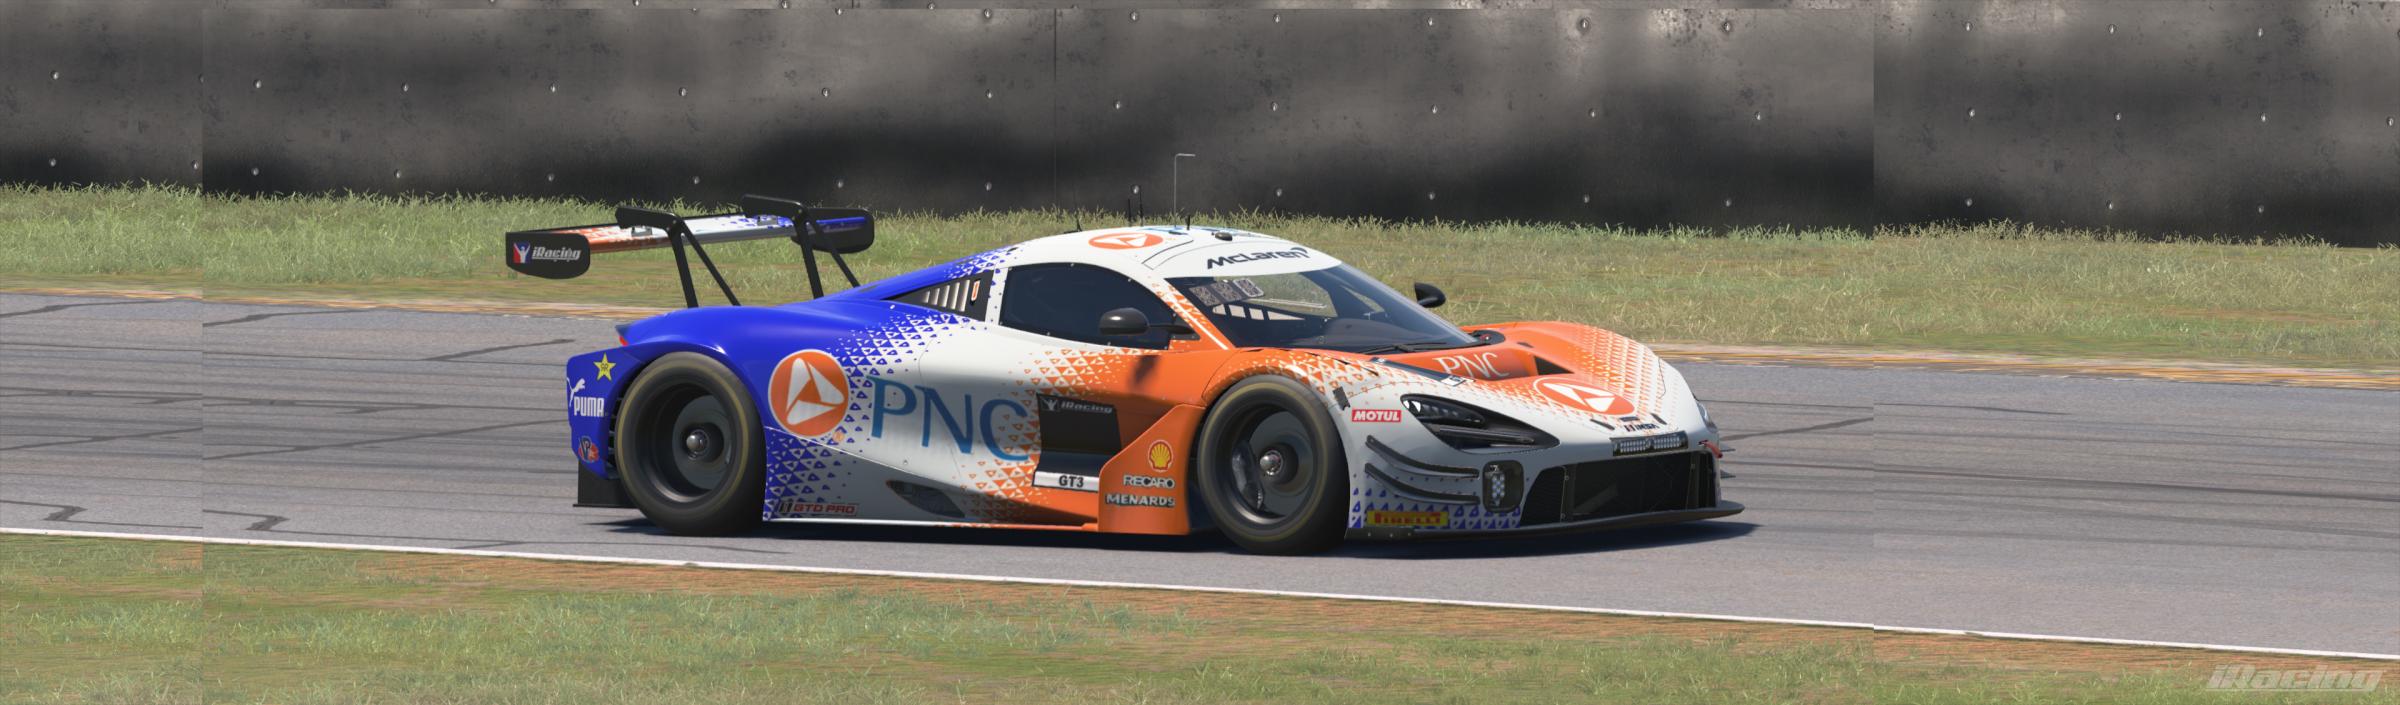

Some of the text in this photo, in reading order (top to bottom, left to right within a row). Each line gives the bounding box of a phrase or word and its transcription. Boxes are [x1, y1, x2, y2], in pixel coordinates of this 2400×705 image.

[532, 246, 582, 261] iRacing
[1207, 247, 1310, 269] McLaren
[1432, 352, 1510, 378] PNC
[573, 396, 605, 417] PUMA
[1060, 401, 1113, 414] iRacing
[866, 375, 1029, 461] PNC
[1353, 411, 1400, 422] MOTUL
[1058, 475, 1085, 488] GT3
[1122, 474, 1175, 488] RECARO
[1106, 493, 1175, 507] MENARDS
[793, 503, 856, 514] GTD PRO
